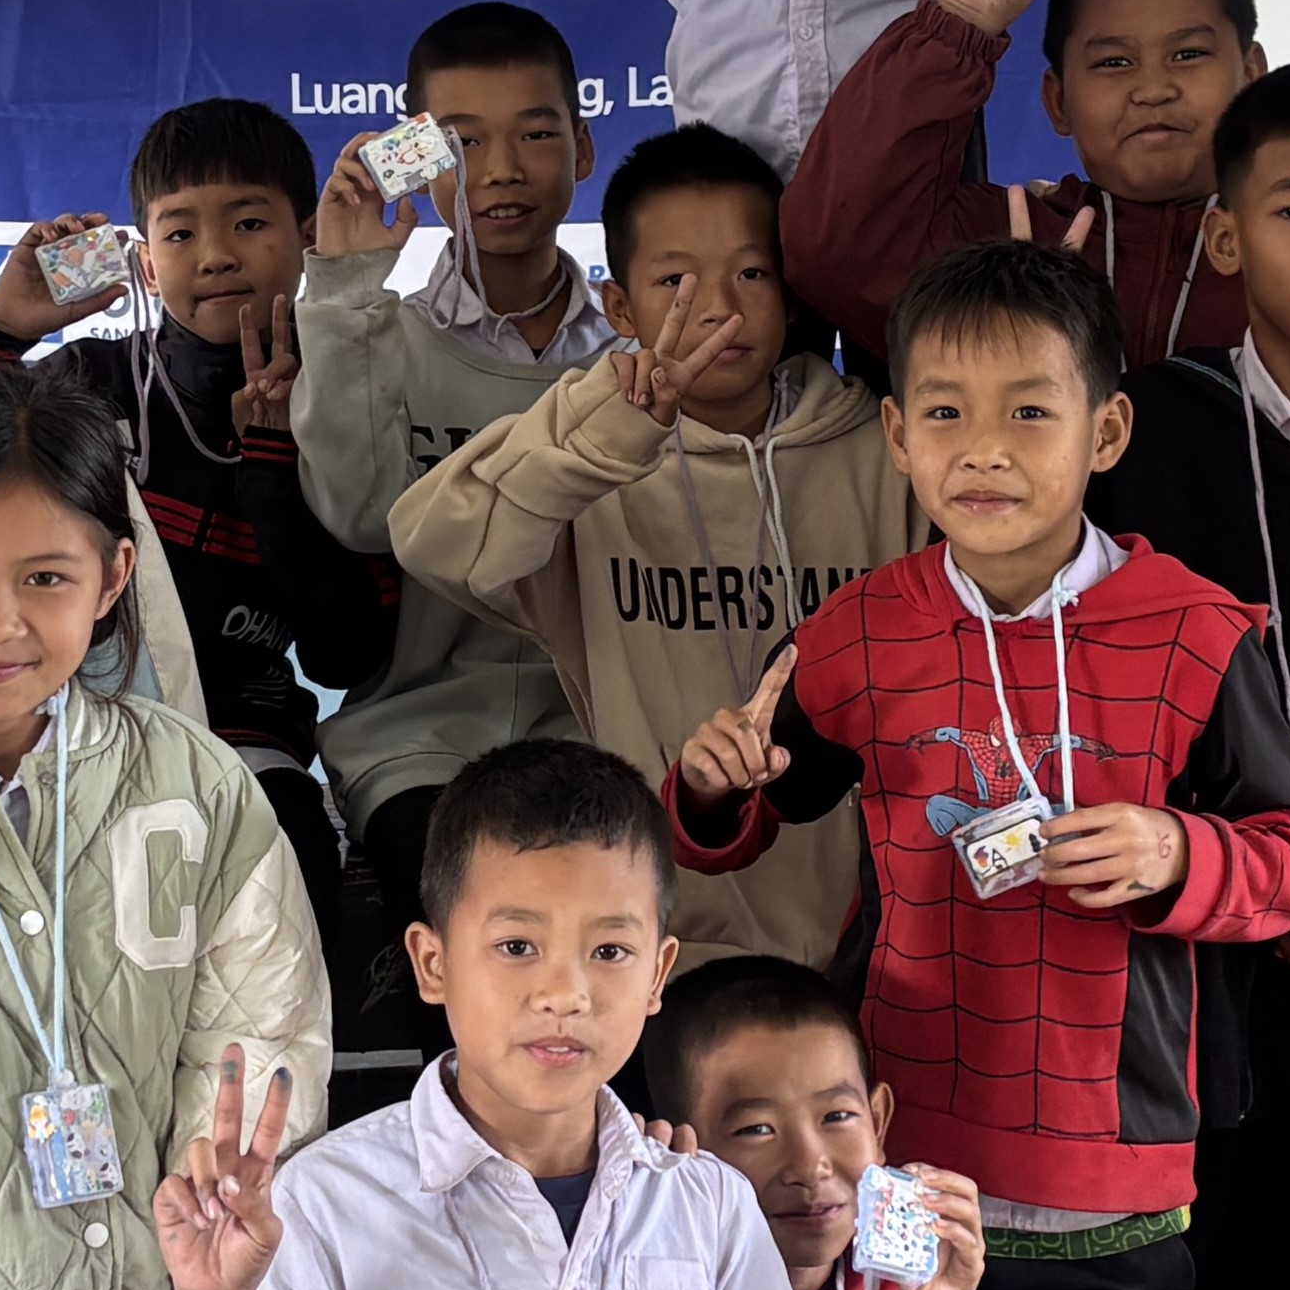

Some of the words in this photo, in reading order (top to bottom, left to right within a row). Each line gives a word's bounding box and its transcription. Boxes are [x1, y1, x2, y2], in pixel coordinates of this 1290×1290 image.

[628, 66, 674, 107] La
[610, 558, 873, 630] UNDERSTA
[110, 798, 209, 971] C
